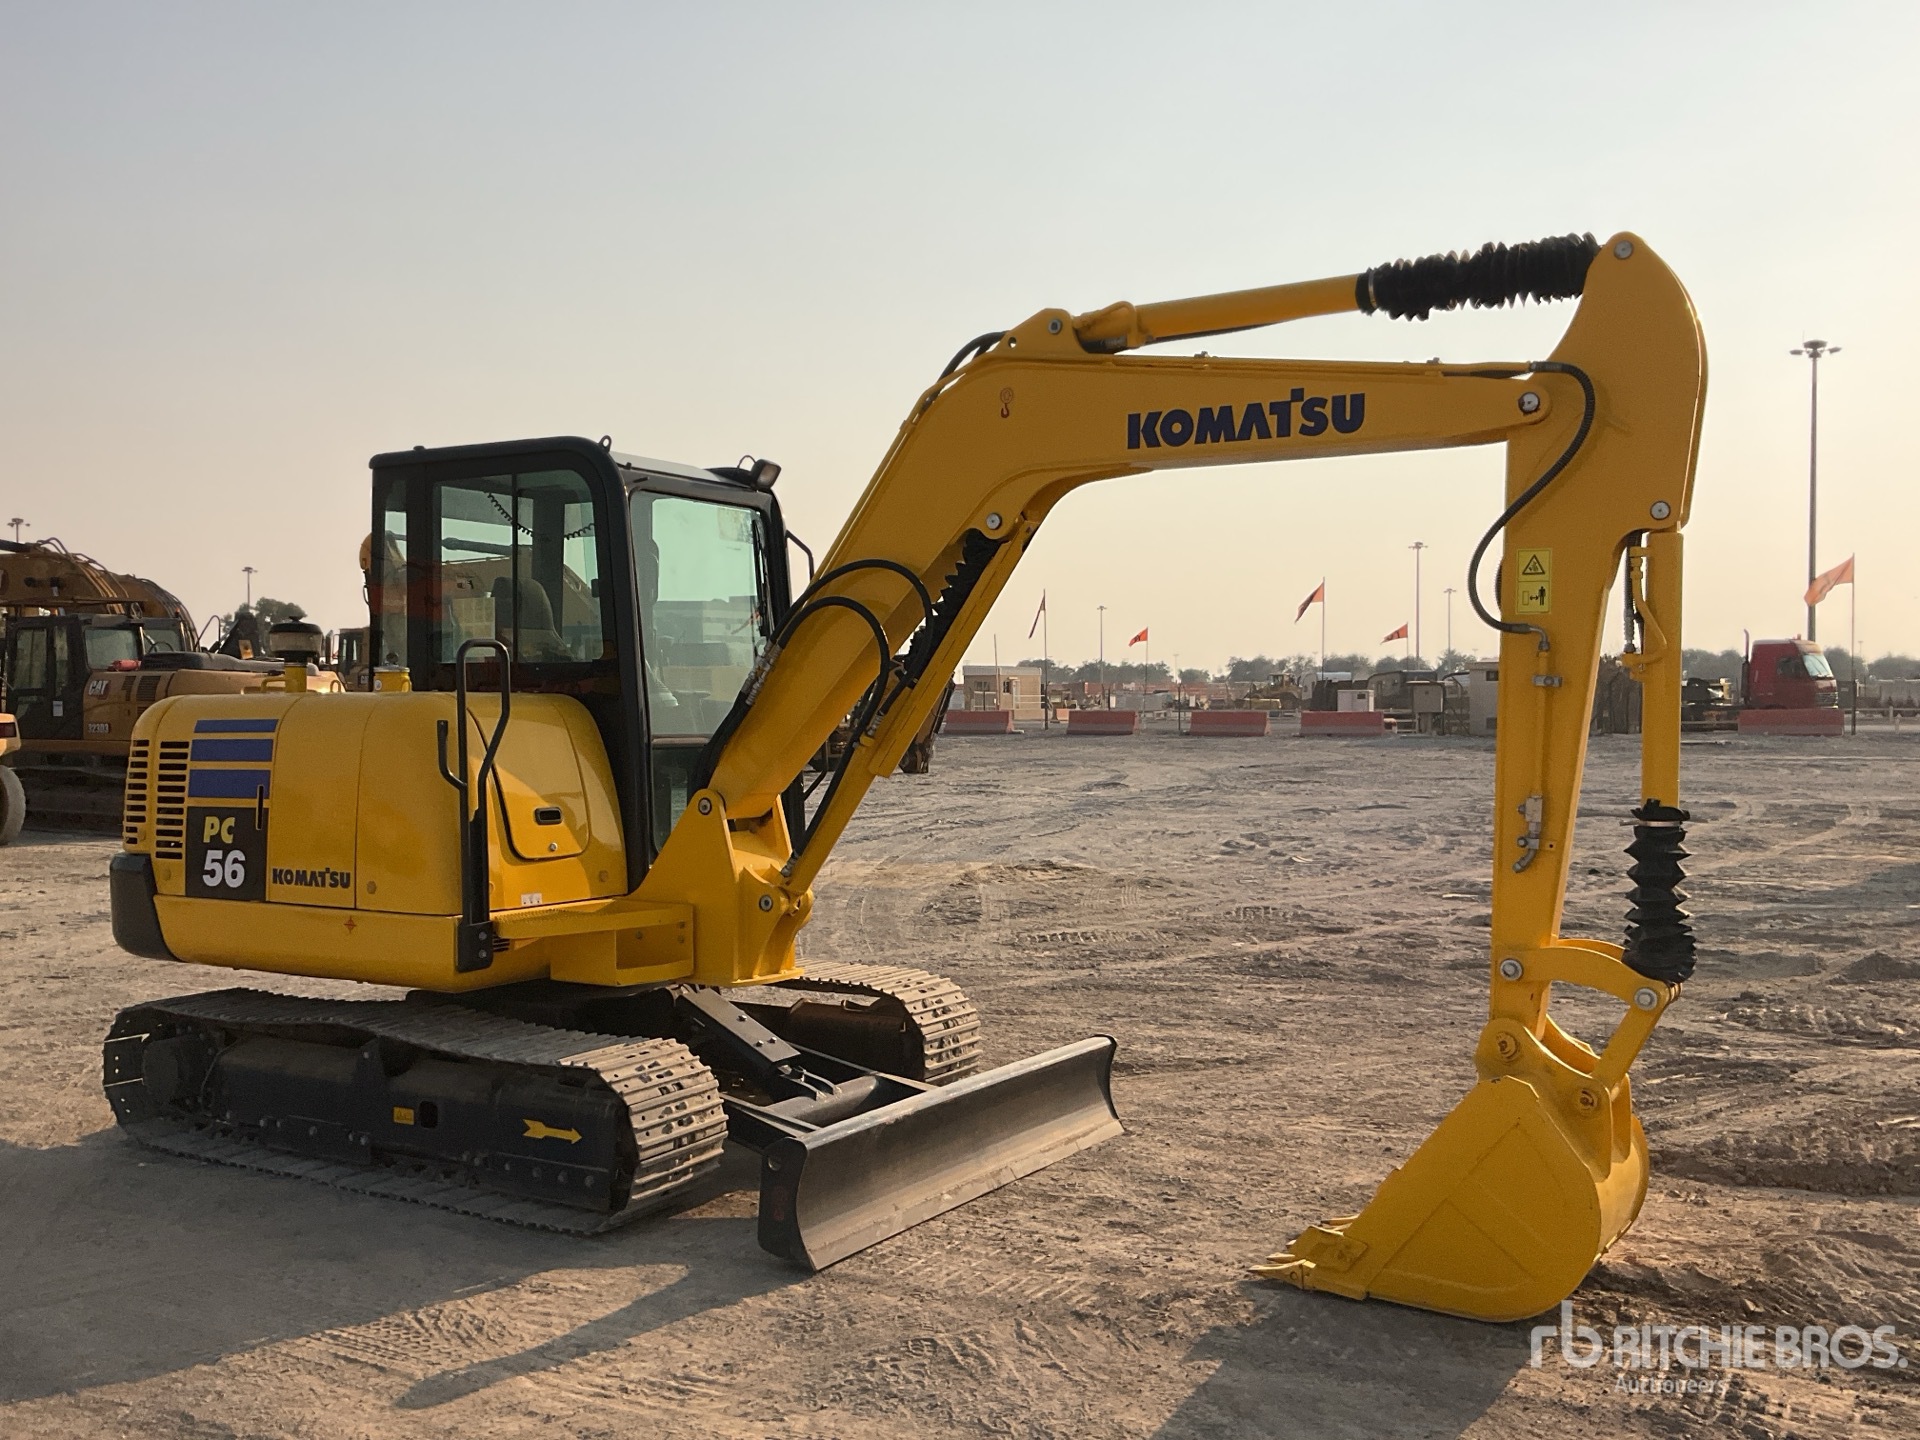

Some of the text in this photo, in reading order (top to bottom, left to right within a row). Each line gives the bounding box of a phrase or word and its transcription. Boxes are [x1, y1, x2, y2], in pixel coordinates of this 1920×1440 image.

[1127, 388, 1365, 449] KOMATSU
[88, 680, 109, 696] CAT
[203, 816, 236, 844] PC
[202, 850, 246, 888] 56
[272, 867, 351, 889] KOMATSU
